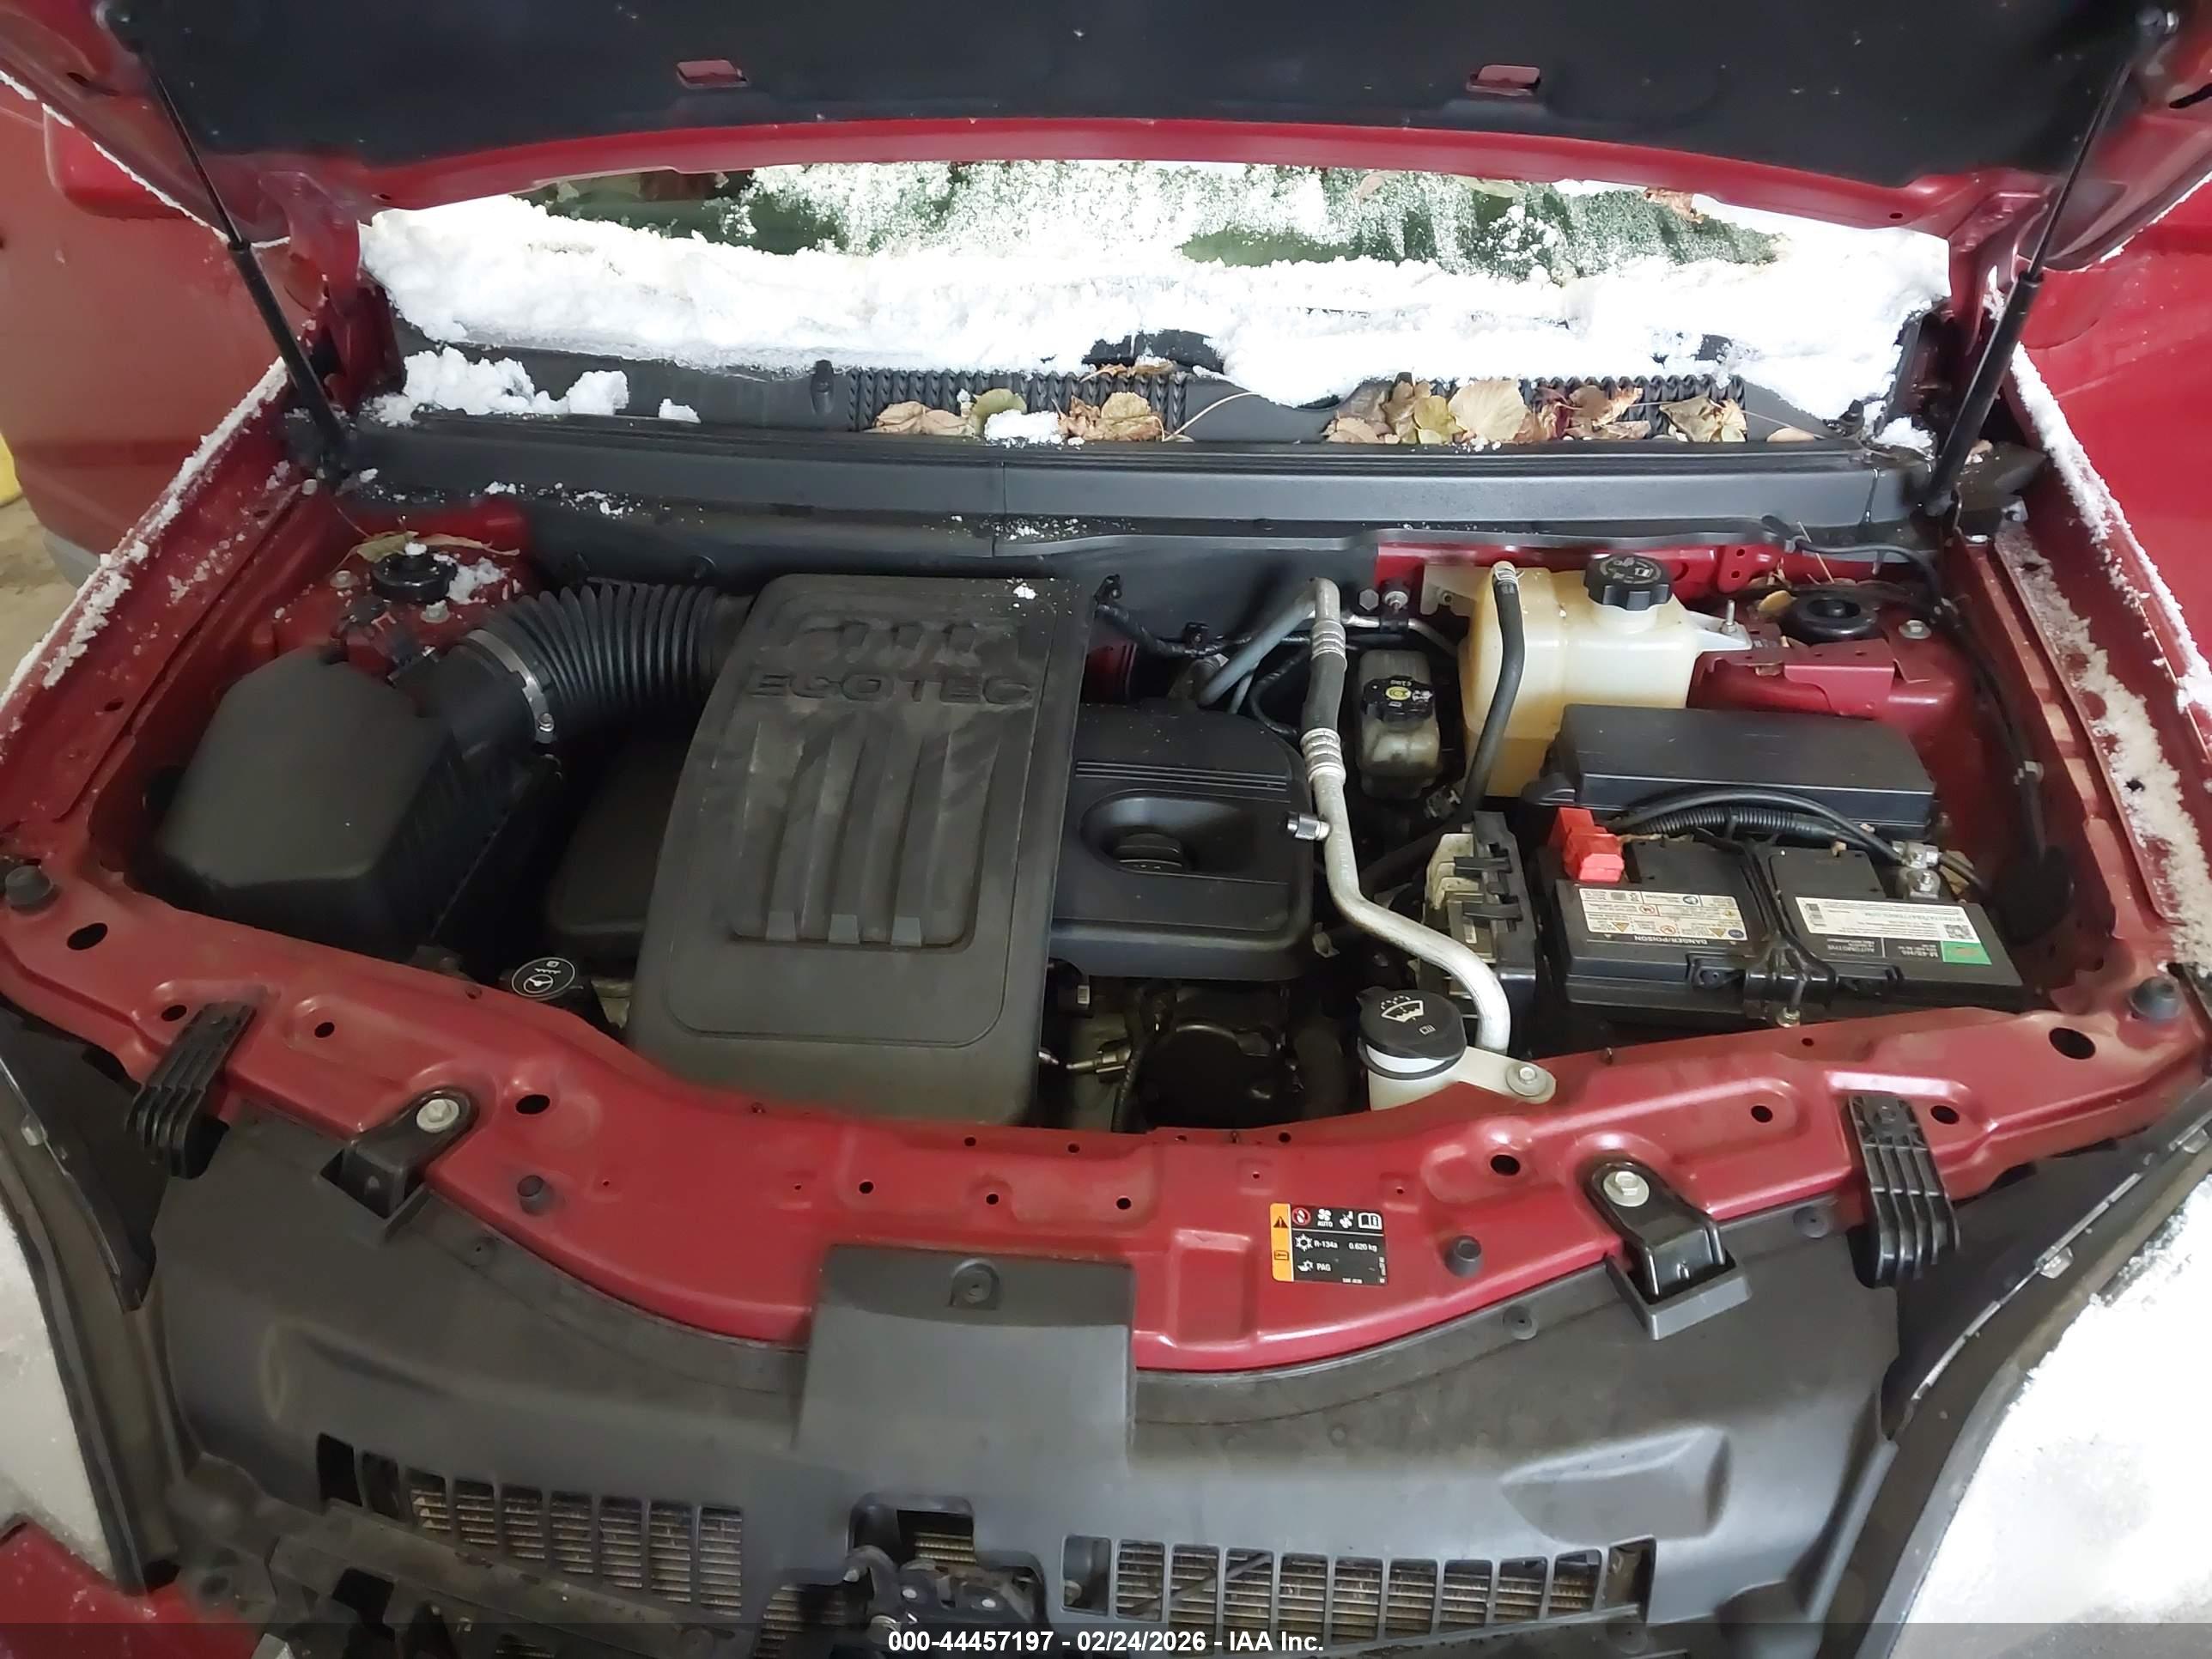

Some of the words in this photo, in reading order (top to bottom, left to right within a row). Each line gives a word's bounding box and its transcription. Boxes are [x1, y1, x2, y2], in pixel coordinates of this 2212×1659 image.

[750, 672, 1033, 706] ECOTEC
[1634, 934, 1708, 945] DANGER/POISON
[1826, 944, 1875, 953] AUTOMOTIVE
[1314, 1240, 1338, 1249] R-134a
[1348, 1243, 1367, 1251] 0.620
[1368, 1243, 1377, 1252] kg
[1316, 1262, 1331, 1272] PAG
